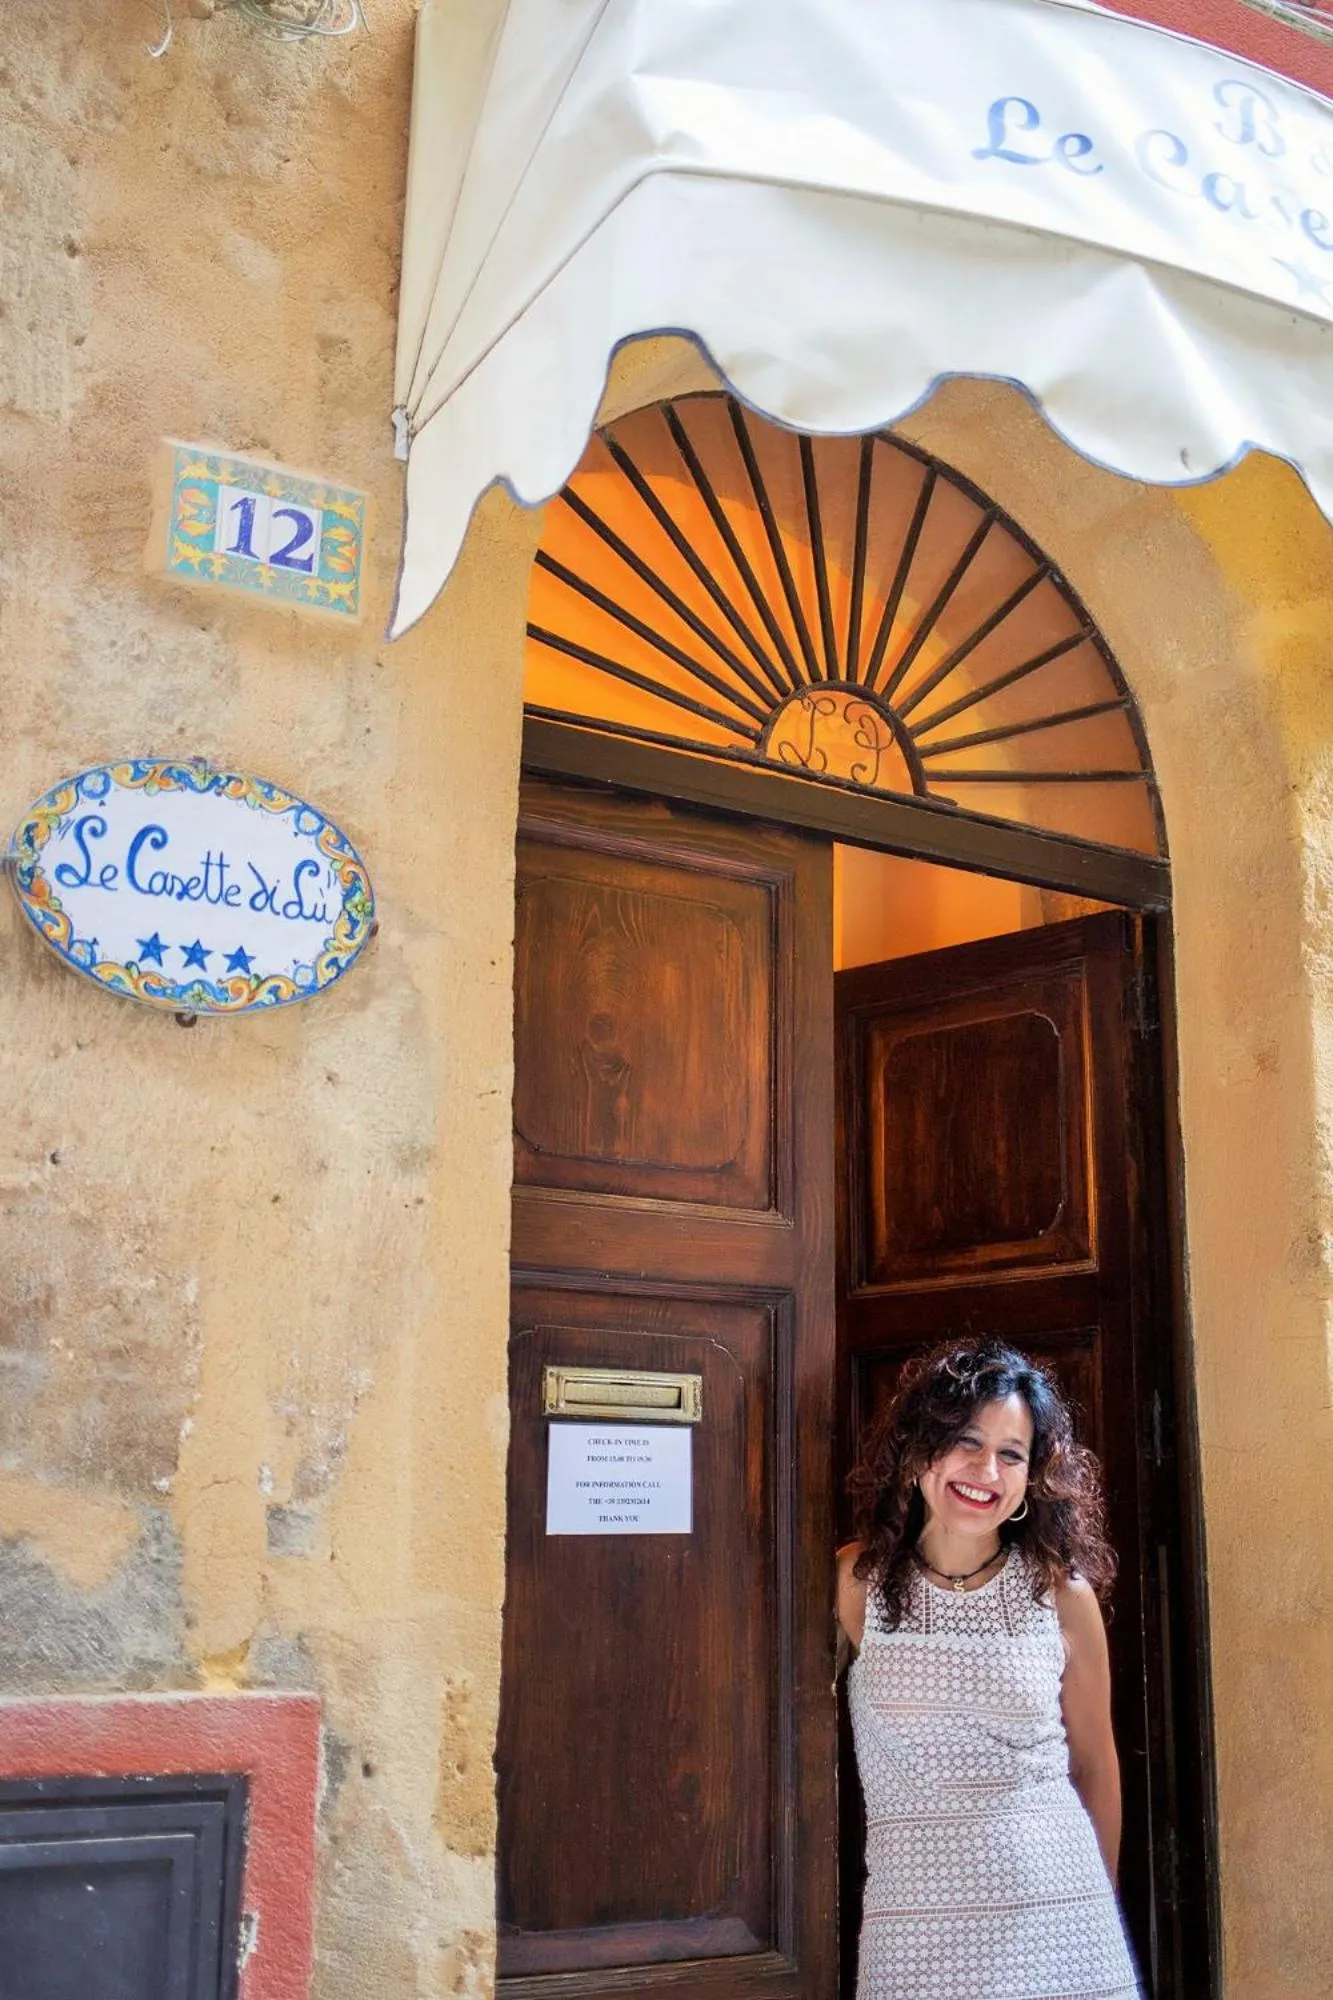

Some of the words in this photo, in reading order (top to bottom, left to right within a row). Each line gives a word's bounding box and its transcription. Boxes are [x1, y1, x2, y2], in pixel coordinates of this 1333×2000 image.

[970, 95, 1104, 177] Le
[225, 496, 315, 573] 12
[54, 814, 119, 892] Le
[126, 823, 243, 907] Casette
[247, 861, 281, 916] di
[575, 1480, 590, 1488] FOR
[591, 1480, 641, 1488] INFORMATION
[642, 1480, 661, 1488] CALL
